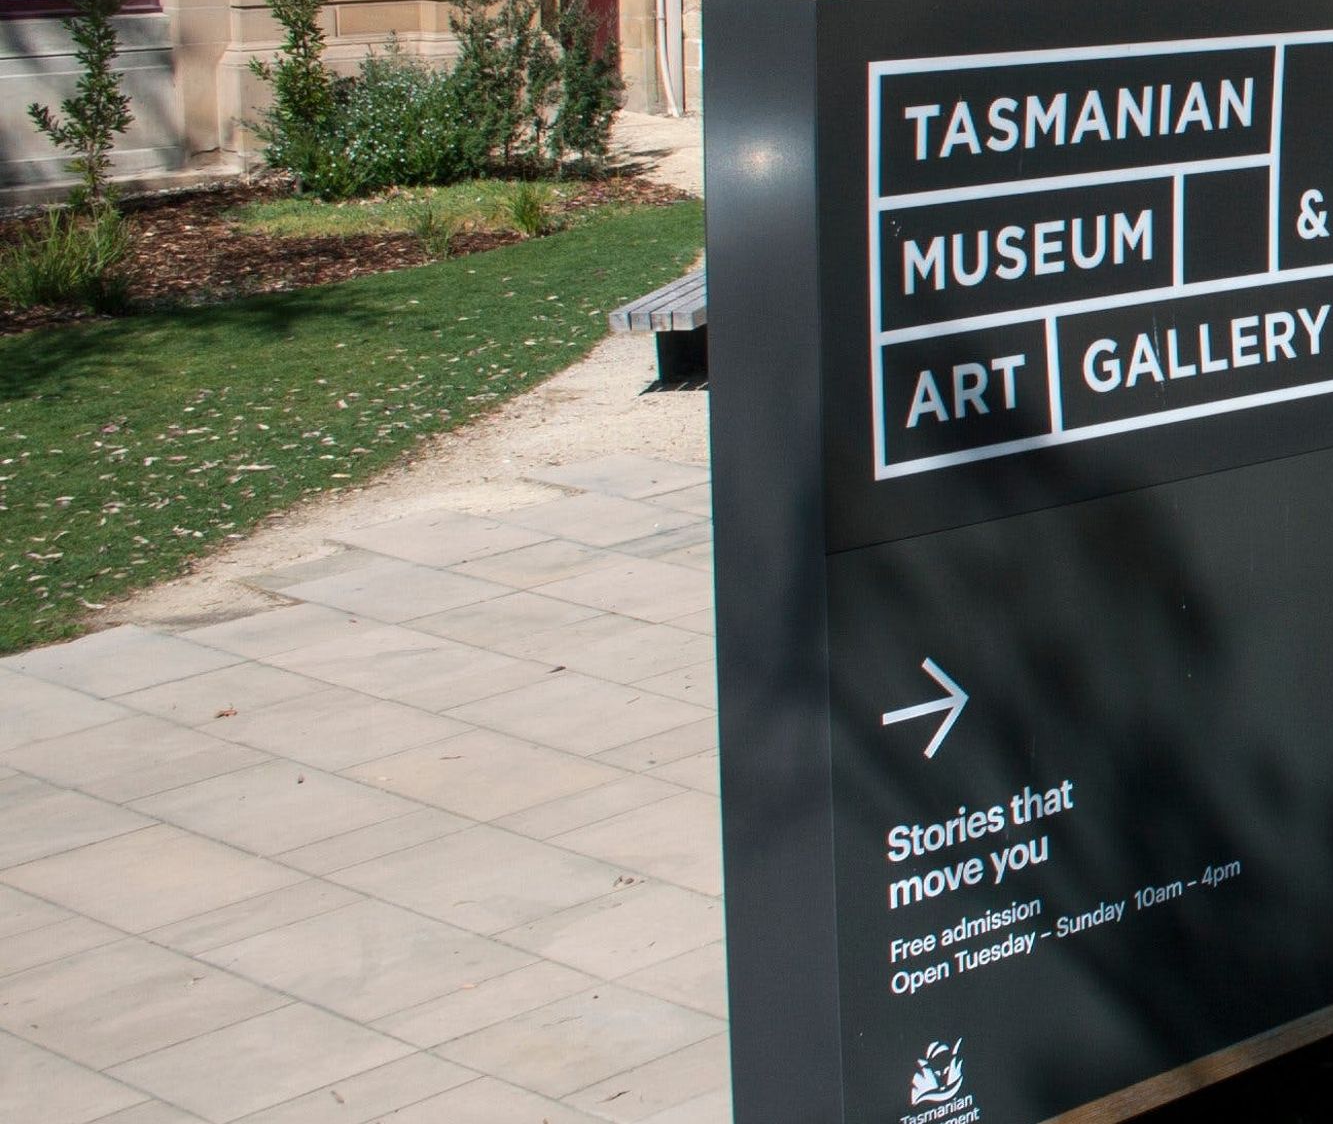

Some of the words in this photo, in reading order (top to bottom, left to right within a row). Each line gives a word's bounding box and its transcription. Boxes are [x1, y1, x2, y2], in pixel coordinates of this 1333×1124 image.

[904, 77, 1254, 161] TASMANIAN
[903, 209, 1153, 295] MUSEUM
[1296, 189, 1330, 239] &
[905, 354, 1026, 429] ART
[1083, 305, 1331, 393] GALLERY
[888, 805, 1005, 862] Stories
[1010, 779, 1074, 825] that
[889, 857, 984, 909] move
[990, 836, 1049, 885] you
[890, 934, 937, 963] Free
[941, 899, 1041, 946] admission
[891, 960, 949, 994] Open
[954, 931, 1036, 973] Tuesday
[1056, 900, 1125, 938] Sunday
[1134, 879, 1183, 911] 10am
[1201, 860, 1241, 888] 4pm
